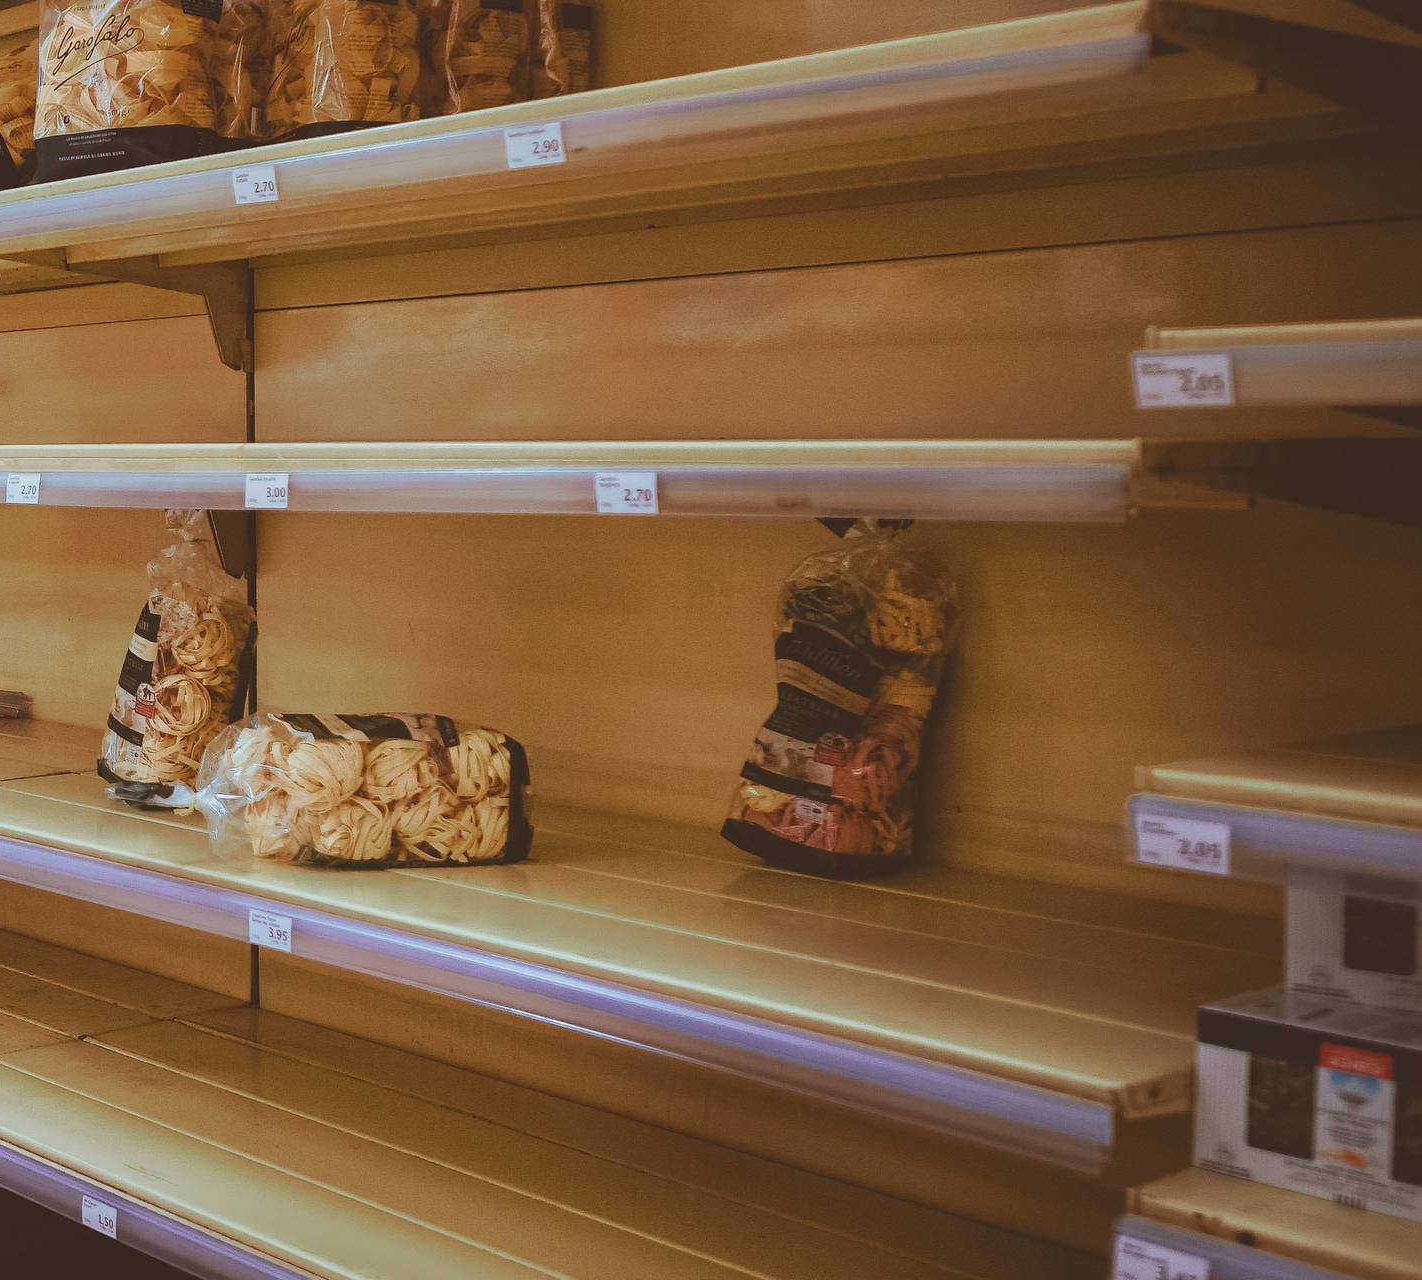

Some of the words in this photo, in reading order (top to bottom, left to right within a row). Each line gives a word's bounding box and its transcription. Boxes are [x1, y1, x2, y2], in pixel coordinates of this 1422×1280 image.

[53, 14, 145, 76] Garofalo
[532, 139, 559, 154] 2.90
[254, 181, 274, 193] 2.70
[21, 485, 37, 495] 2.70
[266, 487, 286, 498] 3.00
[623, 488, 652, 501] 2.70
[268, 927, 288, 941] 3.95
[98, 1213, 114, 1229] 1.50
